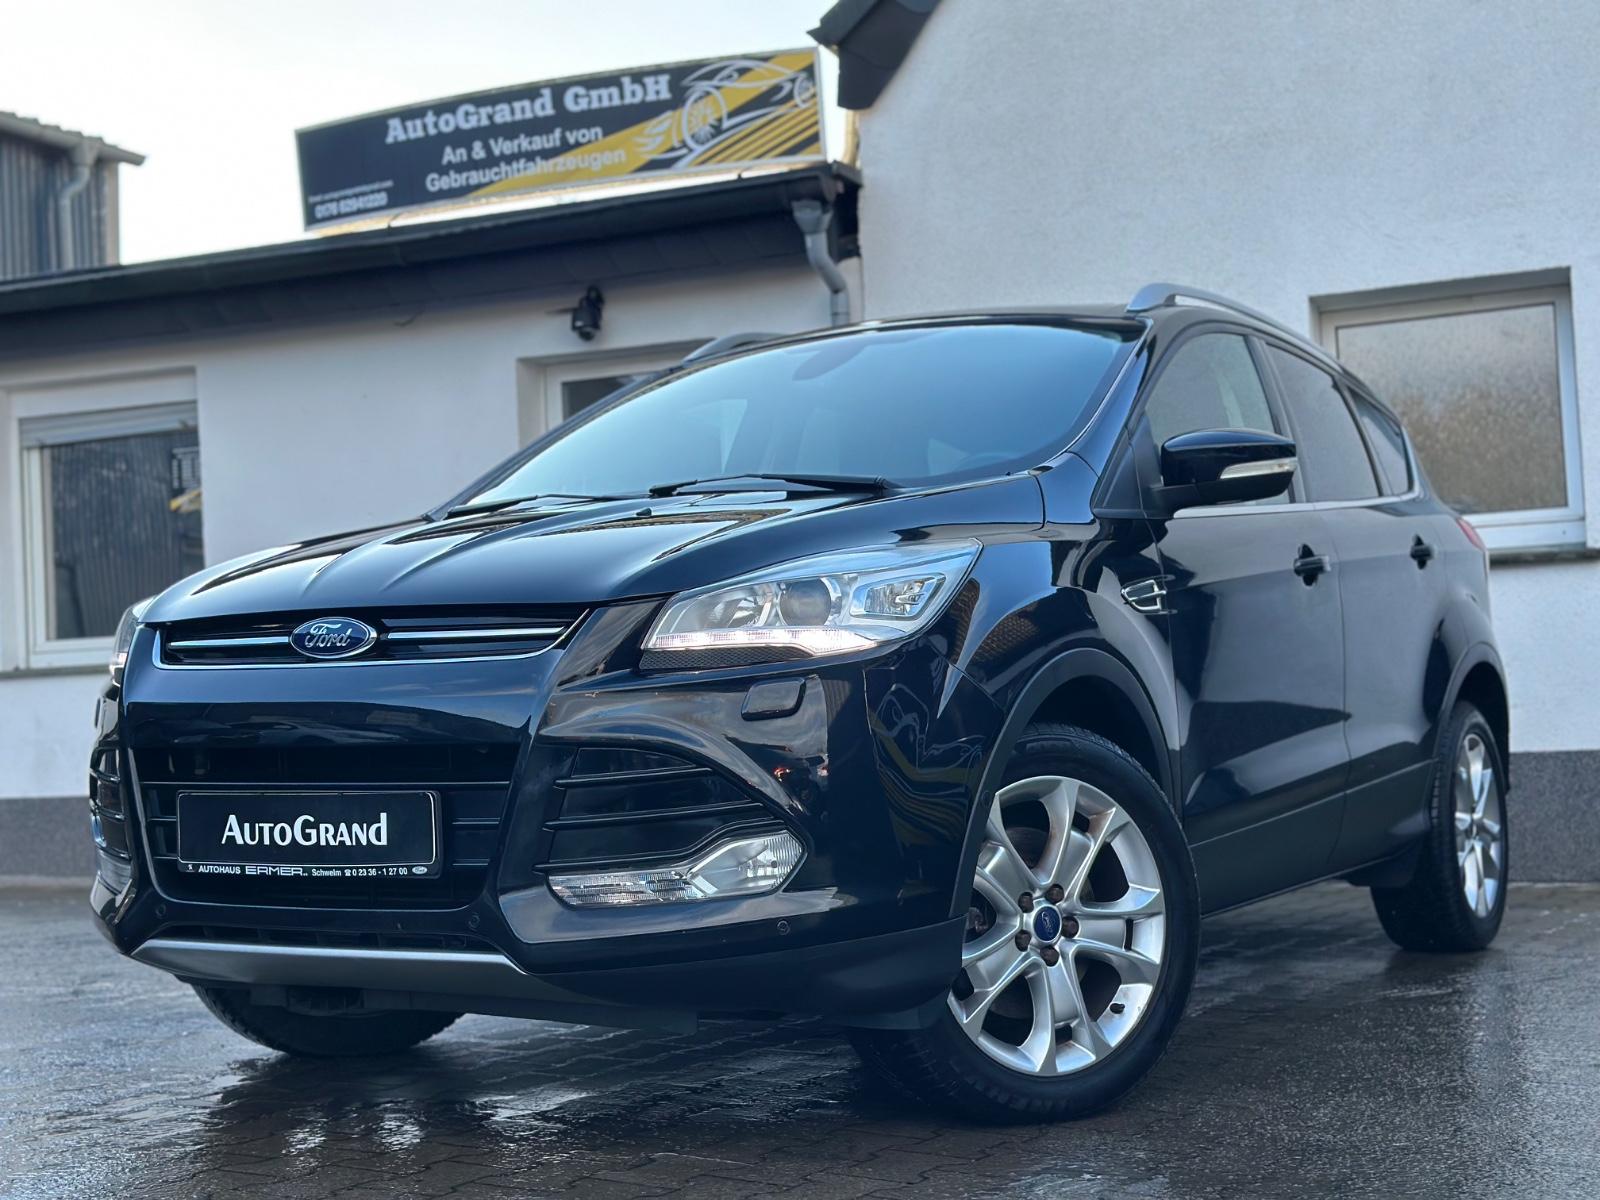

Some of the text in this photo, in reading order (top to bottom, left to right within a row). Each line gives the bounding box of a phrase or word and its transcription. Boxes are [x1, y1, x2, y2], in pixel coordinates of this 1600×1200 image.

[385, 74, 671, 144] AutoGrand GmbH
[442, 126, 603, 165] An & Verkauf von
[425, 149, 627, 192] Gebrauchtfahrzeugen
[305, 623, 352, 648] Ford
[198, 864, 241, 875] AUTOHAUS
[245, 866, 303, 876] ERMER
[311, 868, 342, 877] Schwelm
[358, 867, 367, 877] 23
[368, 867, 377, 876] 36
[388, 866, 397, 875] 27
[399, 866, 408, 876] 00
